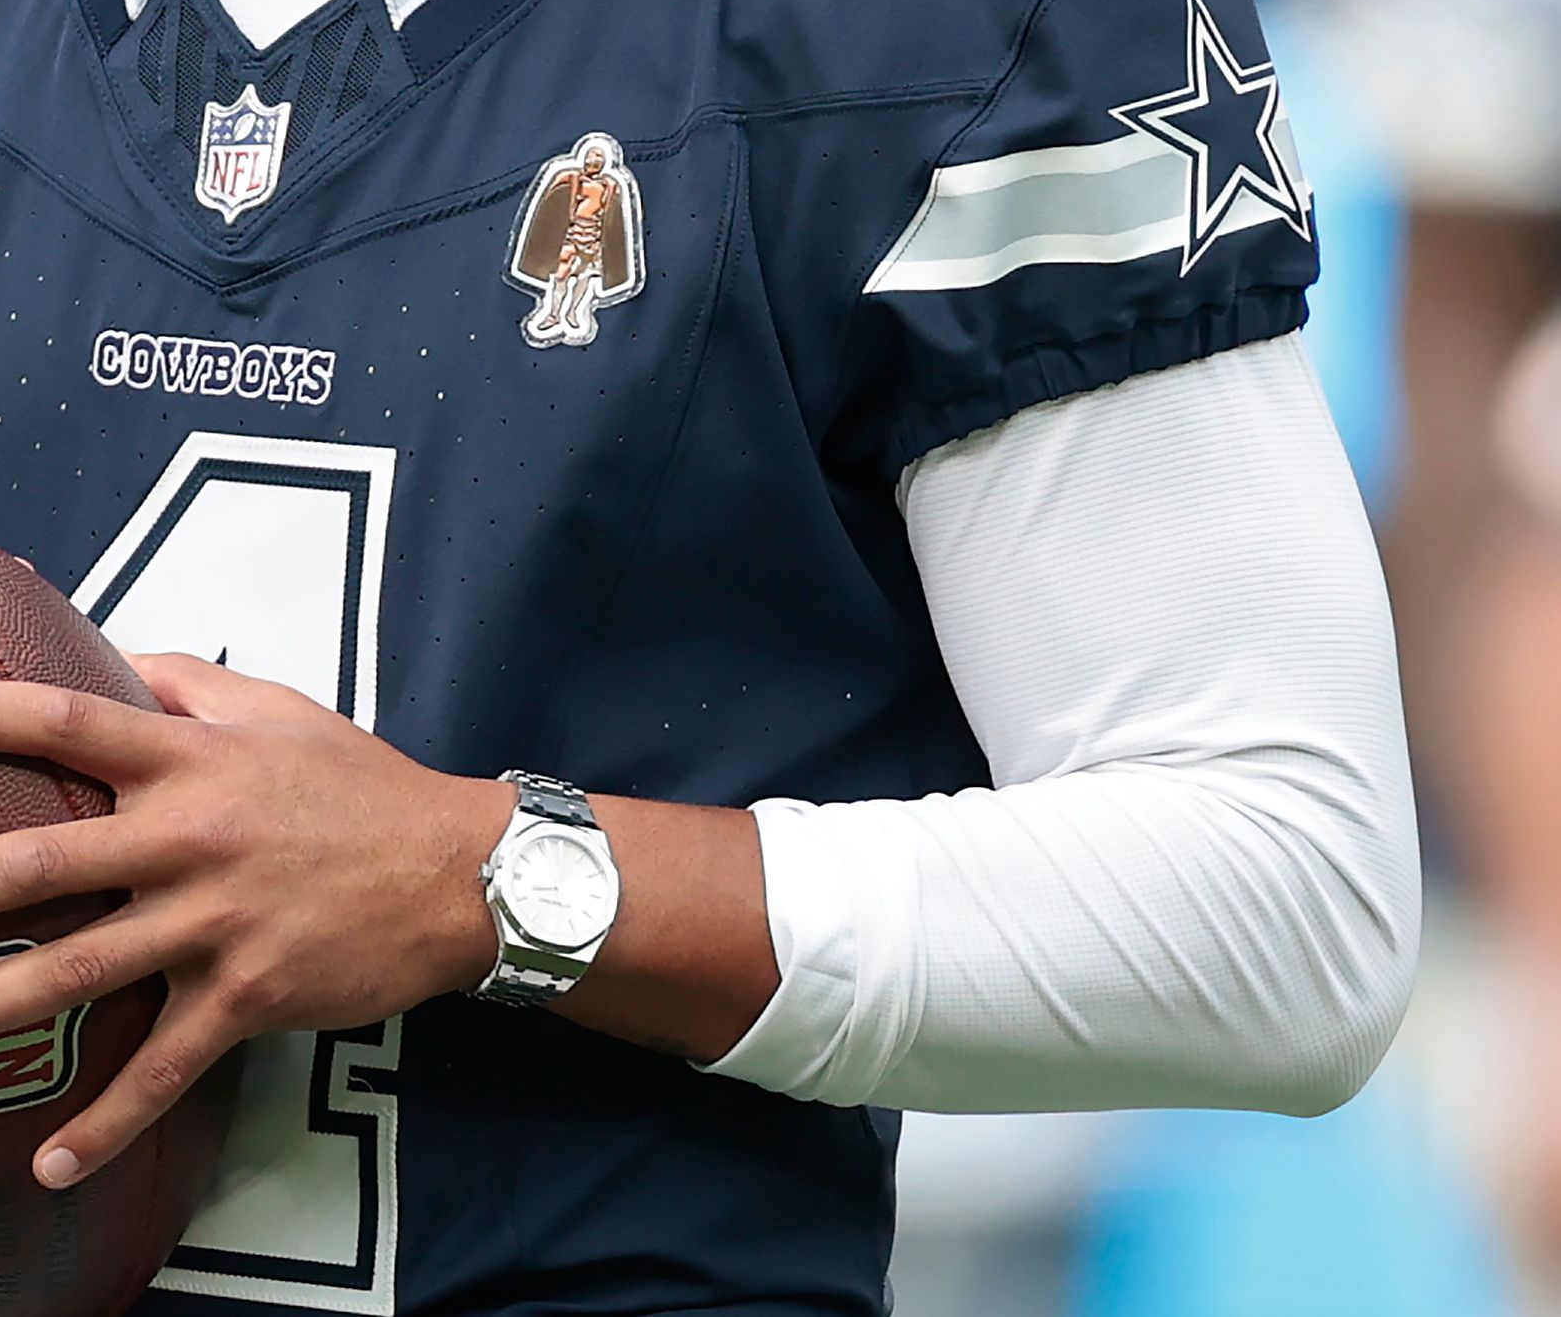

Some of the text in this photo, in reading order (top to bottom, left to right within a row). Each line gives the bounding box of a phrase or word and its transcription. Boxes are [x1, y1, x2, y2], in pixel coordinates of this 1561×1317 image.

[210, 151, 261, 197] NFL
[93, 330, 335, 405] COWBOYS
[71, 431, 398, 1315] 4
